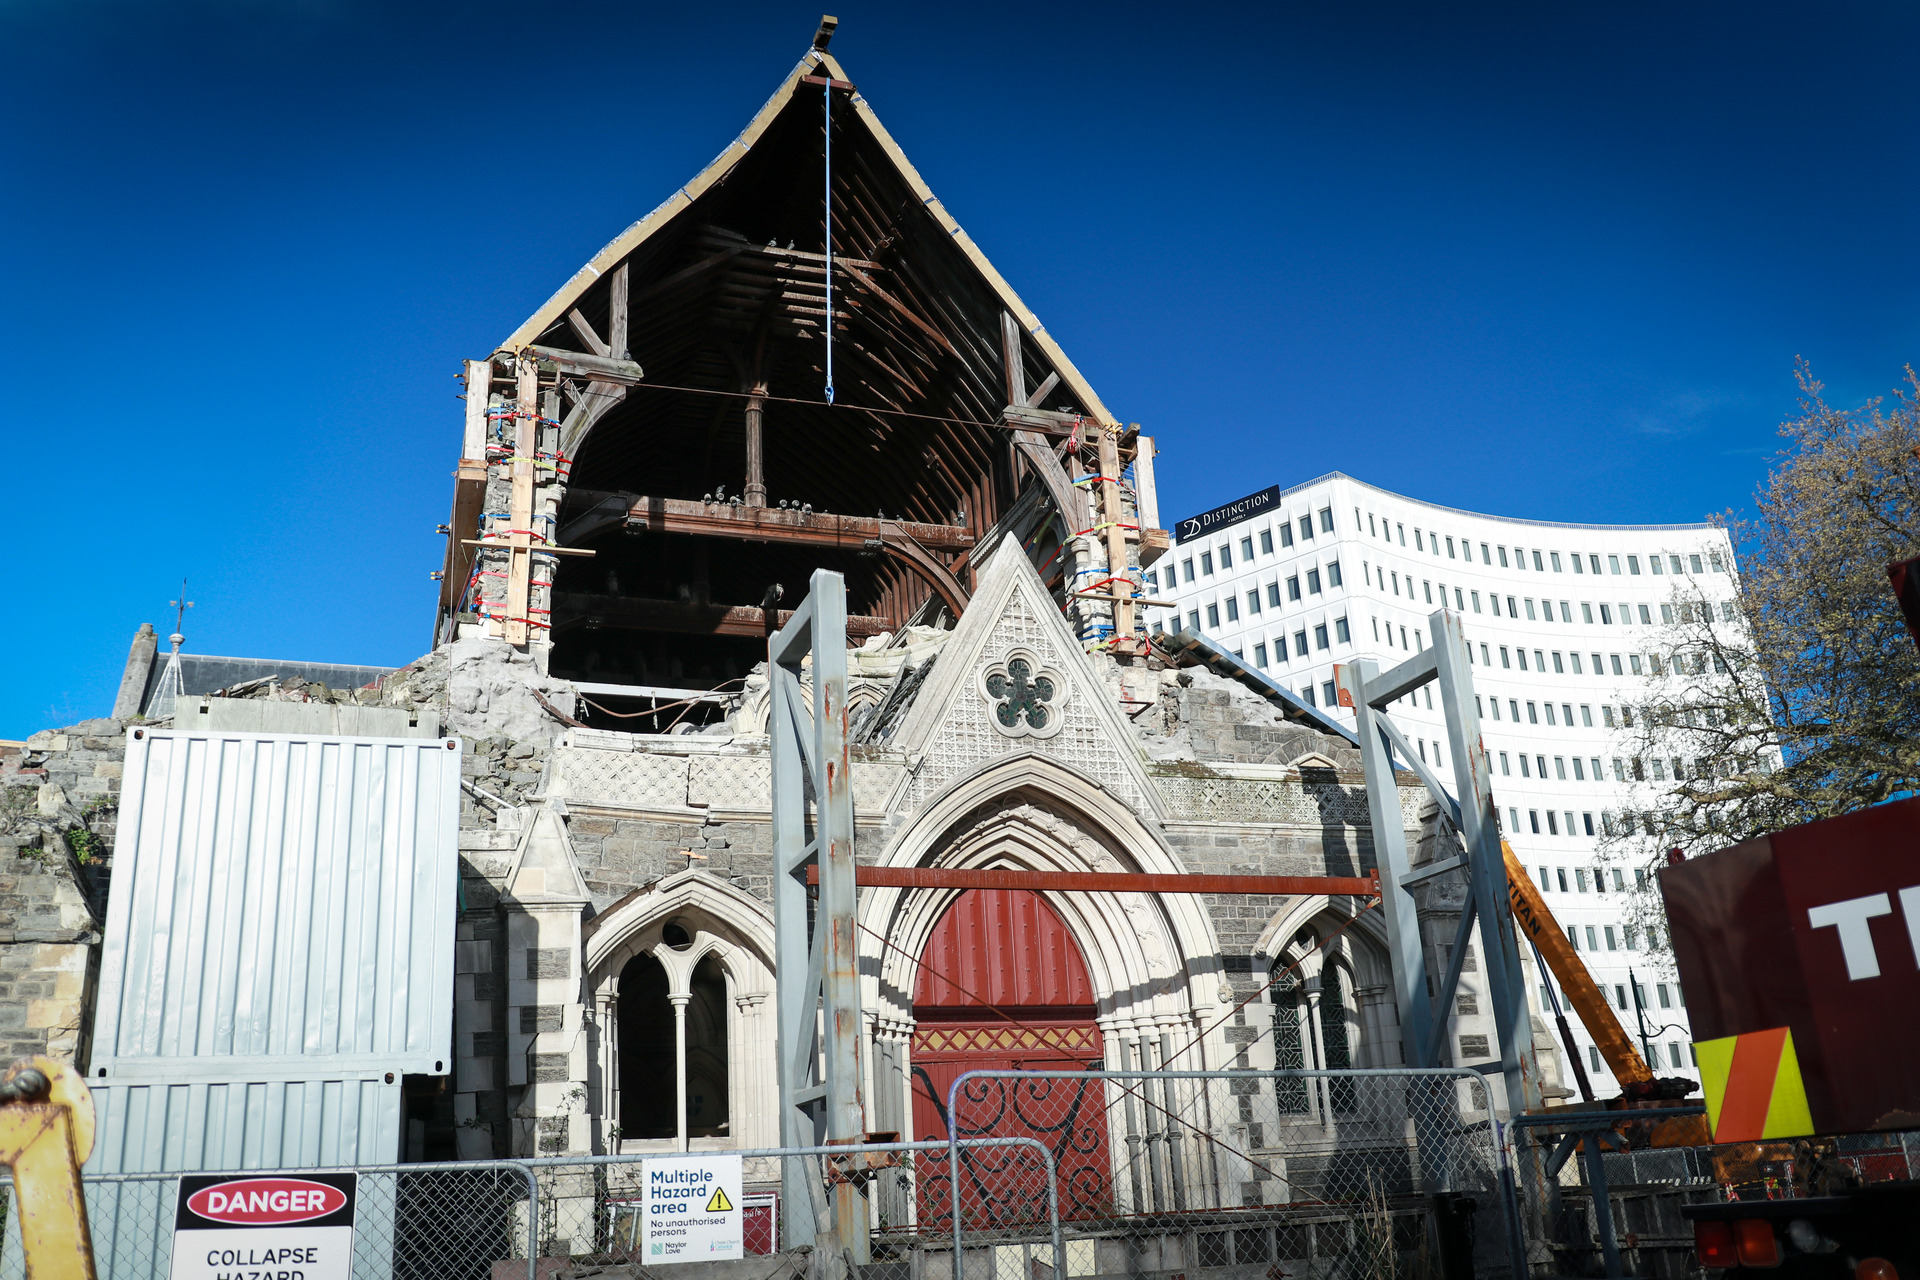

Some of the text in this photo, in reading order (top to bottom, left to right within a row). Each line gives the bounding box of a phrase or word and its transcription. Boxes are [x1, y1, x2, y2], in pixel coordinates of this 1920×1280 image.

[1203, 492, 1269, 526] DISTINCTION
[1508, 877, 1542, 937] TITAN
[651, 1168, 713, 1186] Multiple
[651, 1184, 706, 1199] Hazard
[207, 1190, 326, 1213] DANGER
[651, 1203, 687, 1214] area
[651, 1216, 726, 1228] No unauthorised
[650, 1228, 687, 1238] persons
[207, 1248, 318, 1266] COLLAPSE
